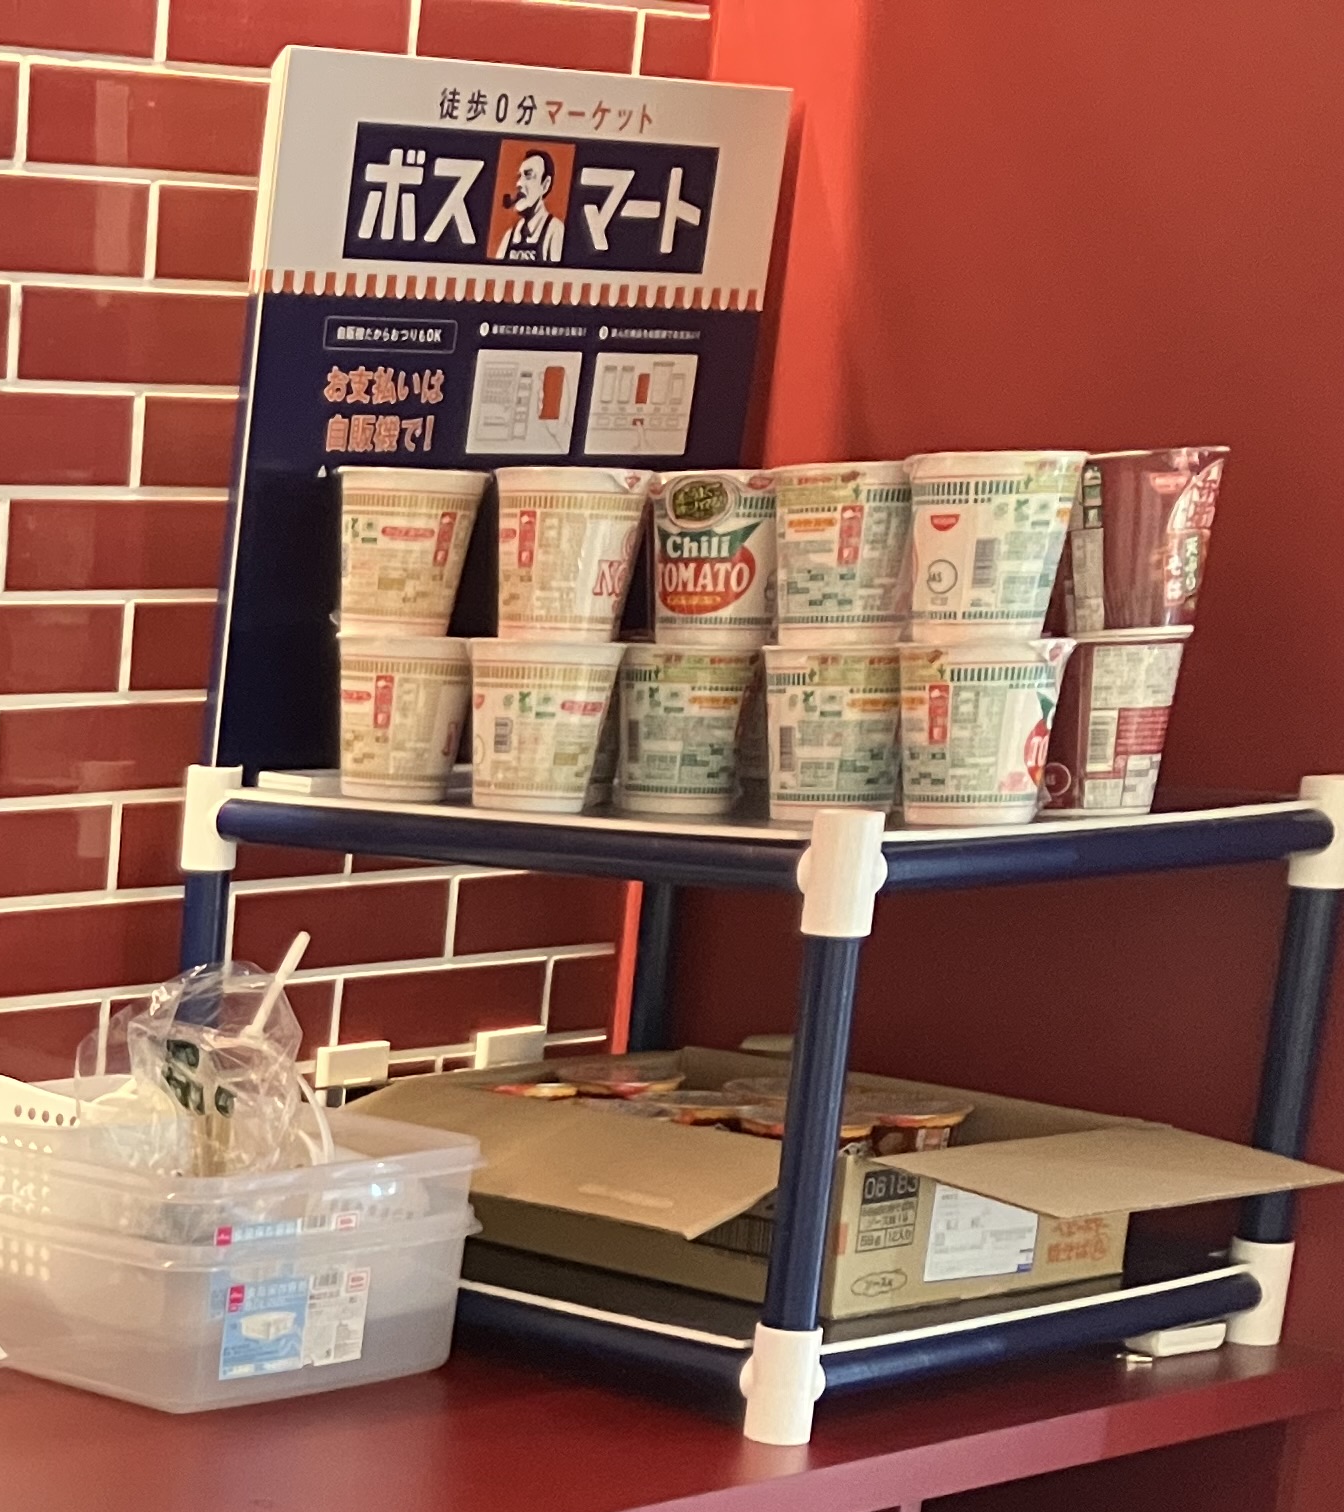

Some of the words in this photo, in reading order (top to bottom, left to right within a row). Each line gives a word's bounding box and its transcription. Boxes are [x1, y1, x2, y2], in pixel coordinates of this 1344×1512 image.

[438, 87, 654, 135] 徒歩0分マーケット
[358, 149, 485, 245] ボス
[578, 167, 701, 255] マート
[324, 365, 444, 405] お支払いは
[326, 414, 436, 452] 自販機で!
[666, 534, 732, 559] Chili
